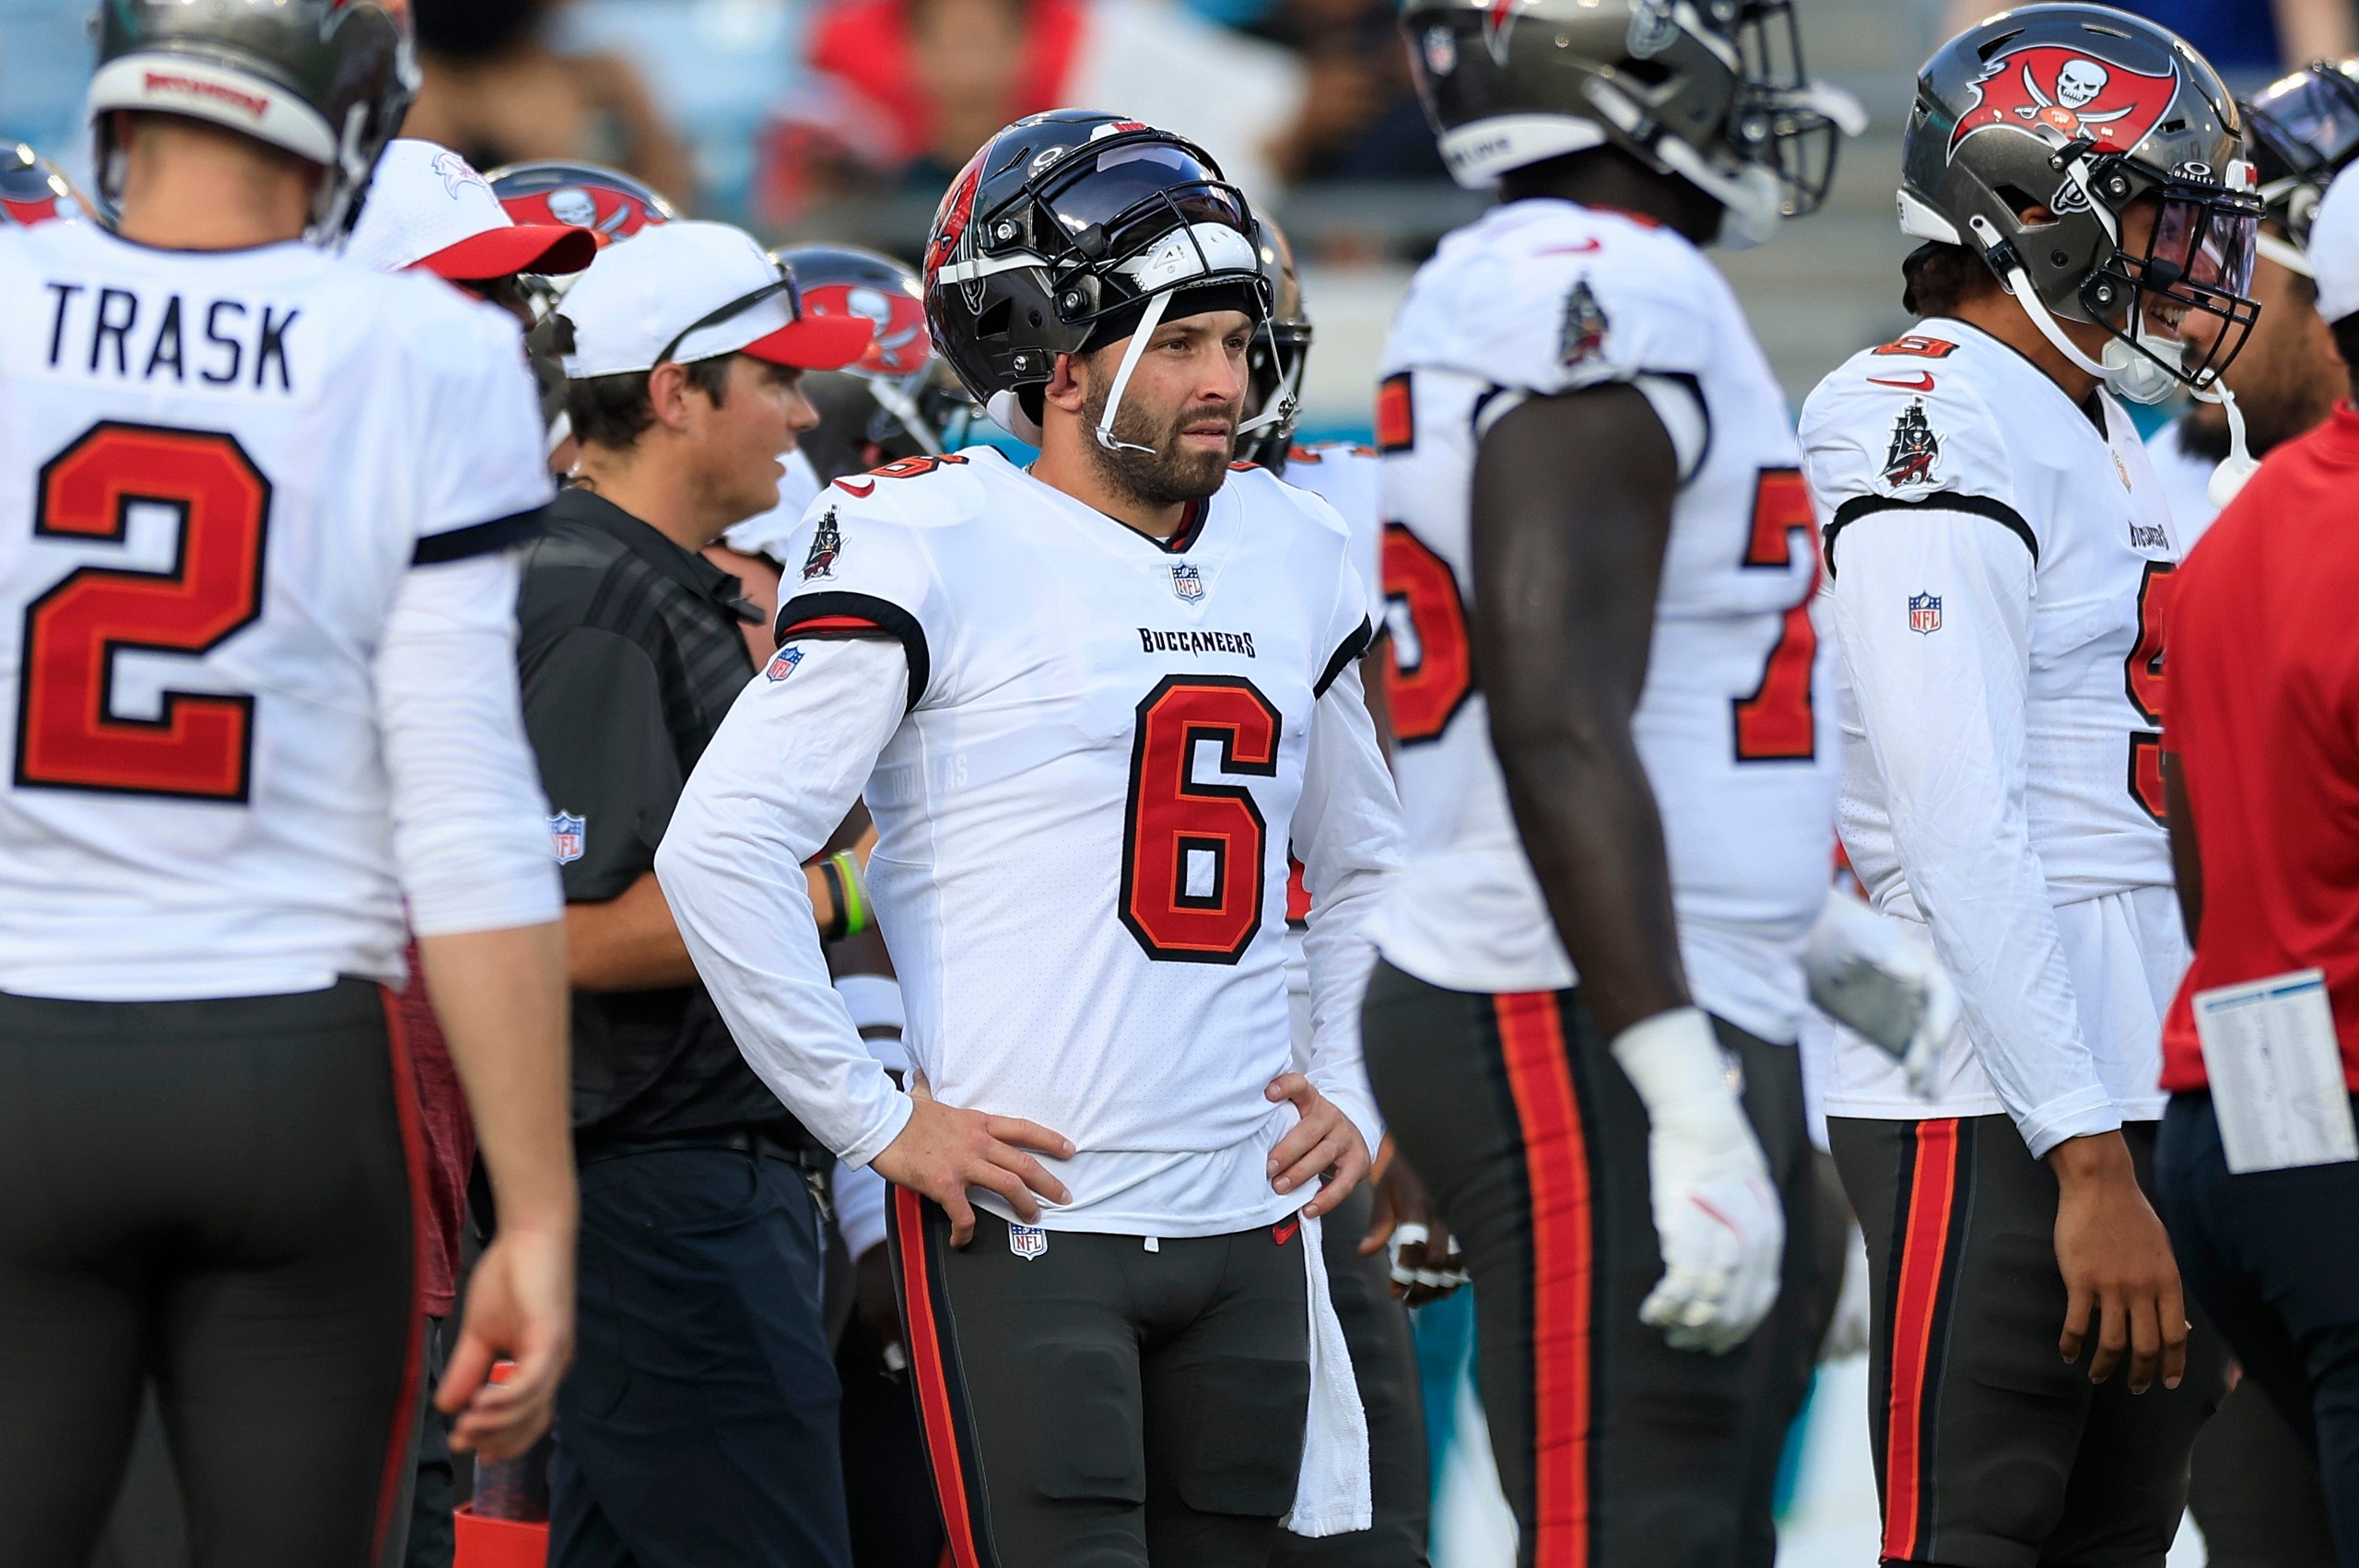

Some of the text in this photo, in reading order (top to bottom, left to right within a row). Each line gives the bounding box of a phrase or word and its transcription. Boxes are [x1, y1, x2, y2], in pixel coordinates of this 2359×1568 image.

[2174, 170, 2215, 184] OAKLEY
[46, 281, 301, 393] TRASK
[1177, 579, 1201, 595] NFL
[13, 419, 273, 806] 2
[1732, 465, 1822, 763] 7
[1911, 611, 1939, 631] NFL
[1136, 627, 1256, 659] BUCCANEERS
[769, 660, 792, 679] NFL
[892, 753, 968, 802] DOULAS
[1118, 673, 1282, 965] 6
[1015, 1235, 1041, 1251] NFL
